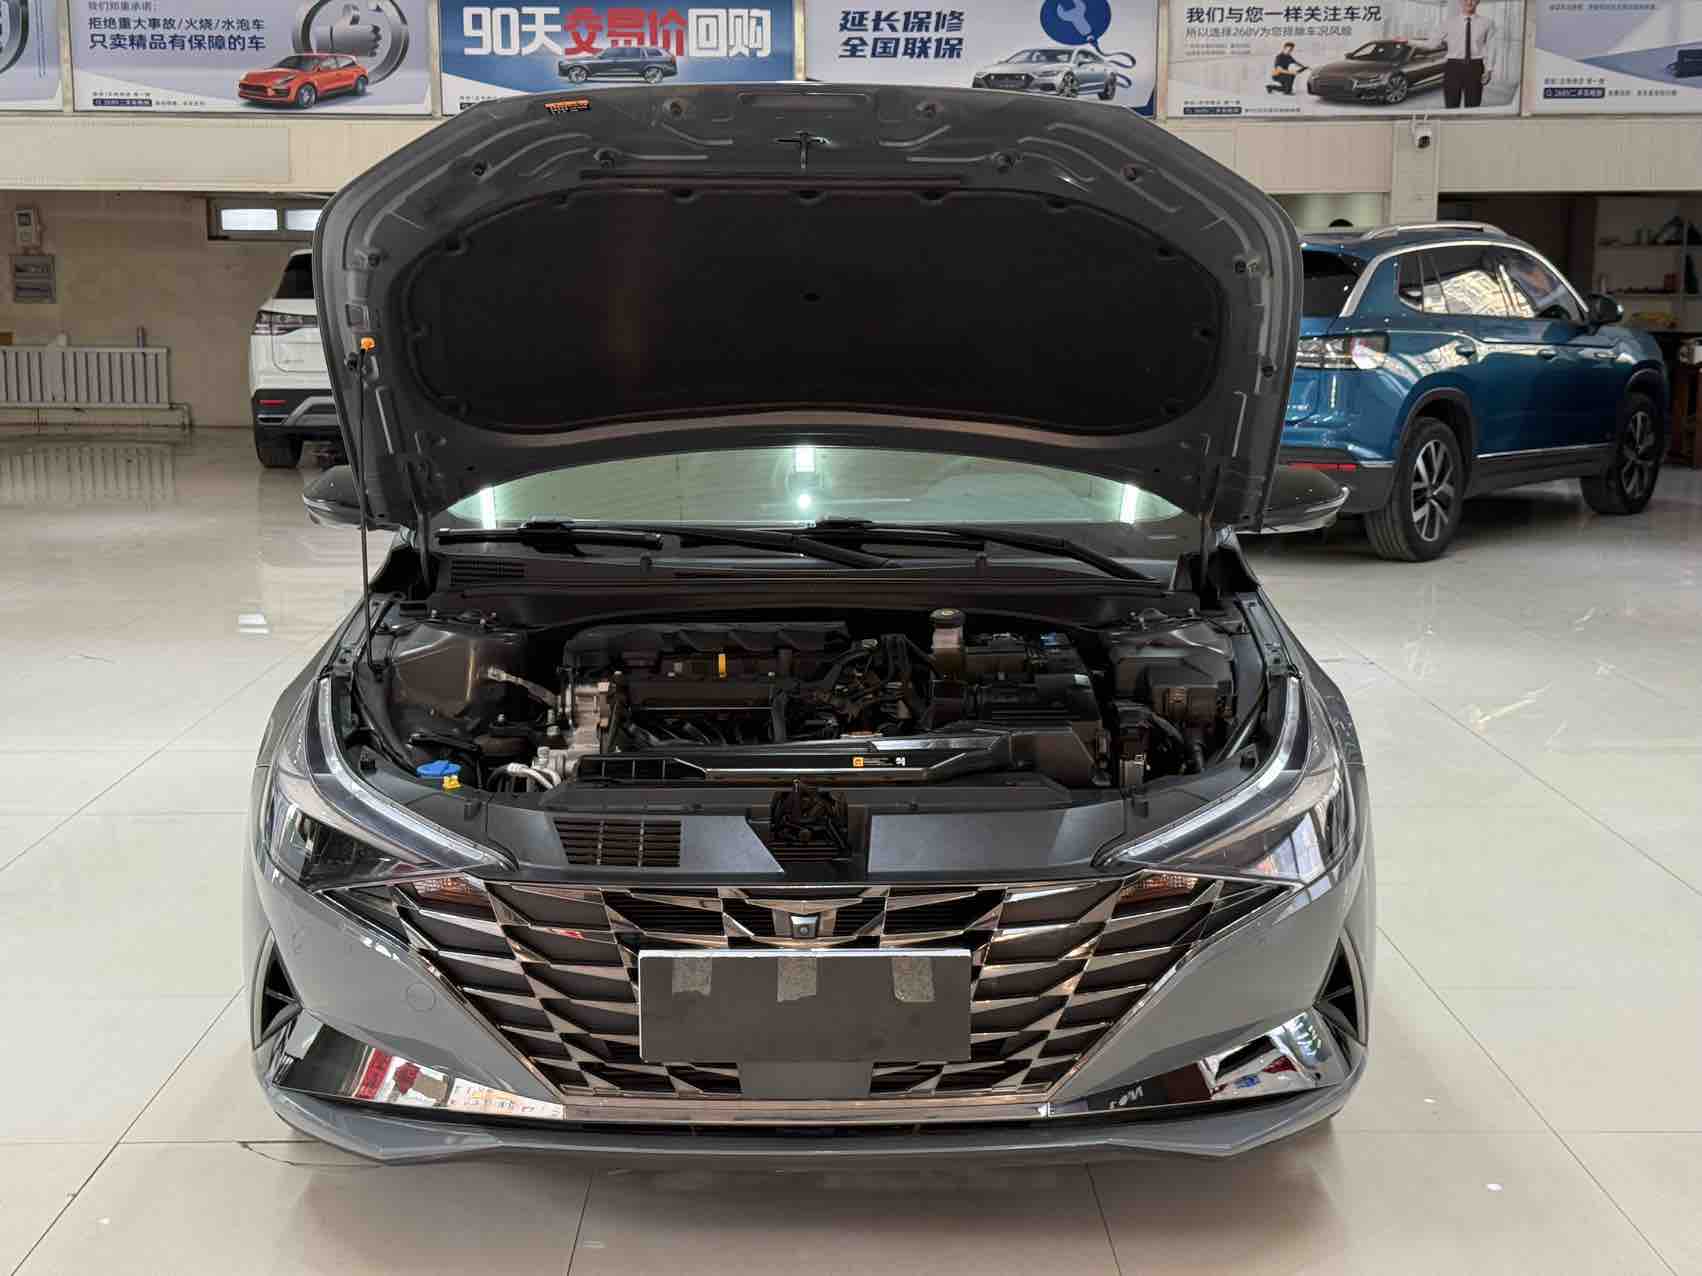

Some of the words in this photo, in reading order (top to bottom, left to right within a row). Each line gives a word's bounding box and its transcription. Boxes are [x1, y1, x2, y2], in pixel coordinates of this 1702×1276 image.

[89, 17, 265, 30] 拒绝重大事故/火烧/水泡车
[839, 10, 965, 33] 延长保修
[1186, 6, 1381, 23] 我们与您一样关注车况
[463, 7, 771, 57] 90天交易价回购
[89, 34, 266, 51] 只卖精品有保障的车
[839, 37, 963, 59] 全国联保
